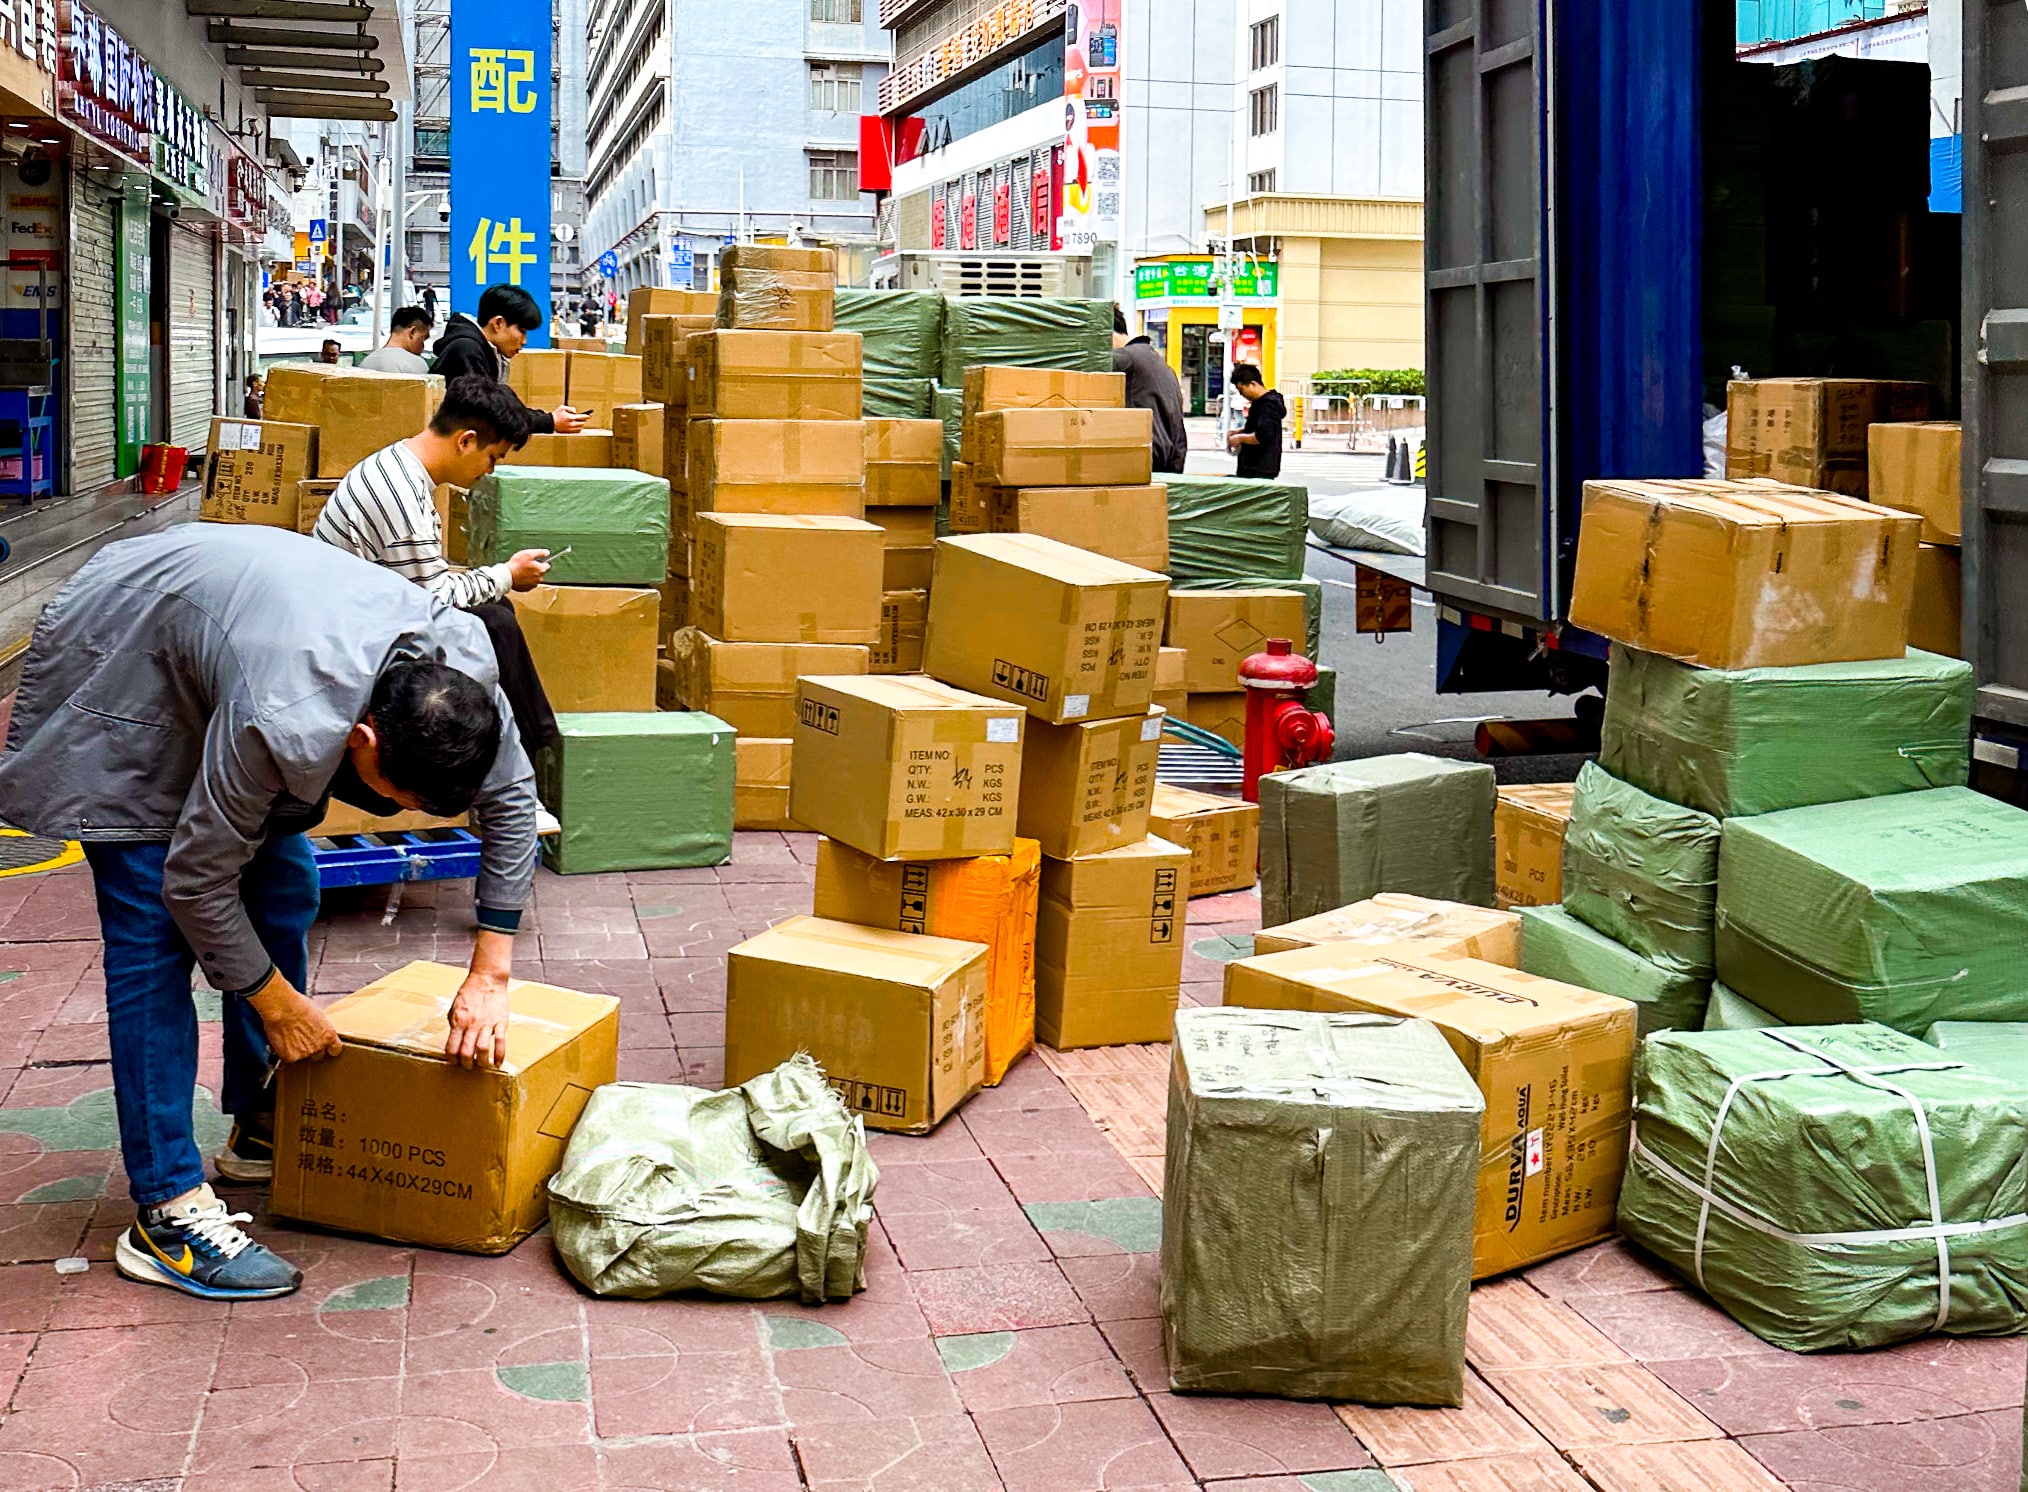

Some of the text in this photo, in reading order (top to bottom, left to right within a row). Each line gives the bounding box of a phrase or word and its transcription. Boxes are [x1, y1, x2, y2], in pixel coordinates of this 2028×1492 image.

[11, 222, 53, 234] FedEx
[1084, 636, 1100, 646] KGS
[1082, 649, 1099, 659] KGS
[1080, 662, 1096, 672] PCS
[909, 750, 933, 761] ITEM
[984, 764, 1004, 774] PCS
[1135, 762, 1150, 773] PCS
[982, 778, 1003, 789] KGS
[982, 792, 1003, 803] KGS
[987, 806, 1003, 817] CM
[1529, 867, 1546, 883] PCS
[1418, 973, 1526, 1004] DURVA
[359, 1136, 403, 1160] 1000
[407, 1145, 447, 1168] PCS
[1505, 1086, 1527, 1222] DURVA AQUA
[1539, 1198, 1548, 1223] Item
